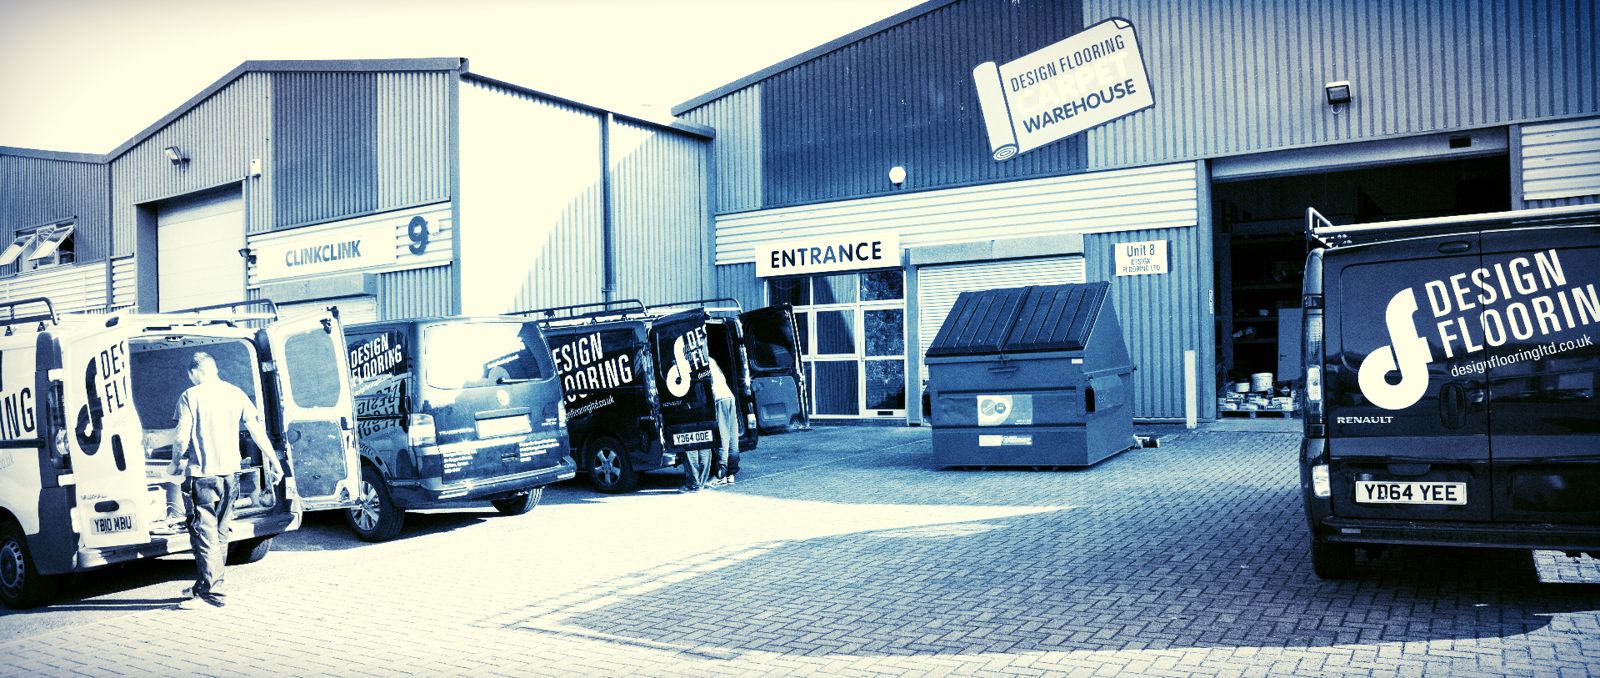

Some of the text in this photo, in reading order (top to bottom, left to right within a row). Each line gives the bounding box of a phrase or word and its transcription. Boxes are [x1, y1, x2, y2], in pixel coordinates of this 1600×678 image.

[1010, 34, 1125, 92] DESIGN FLOORING
[1017, 51, 1128, 114] CARPET
[1023, 78, 1136, 134] WAREHOUSE
[285, 240, 361, 267] CLINKCLINK
[408, 215, 429, 256] 9
[771, 241, 882, 268] ENTRANCE
[1126, 243, 1155, 257] Unit 8
[1425, 249, 1567, 318] DESIGN
[351, 332, 389, 369] DESIGN
[352, 344, 402, 388] FLOORING
[1450, 334, 1593, 378] designflooringltd.co.uk
[1337, 416, 1394, 424] RENAULT
[1364, 484, 1457, 501] YD64 YEE
